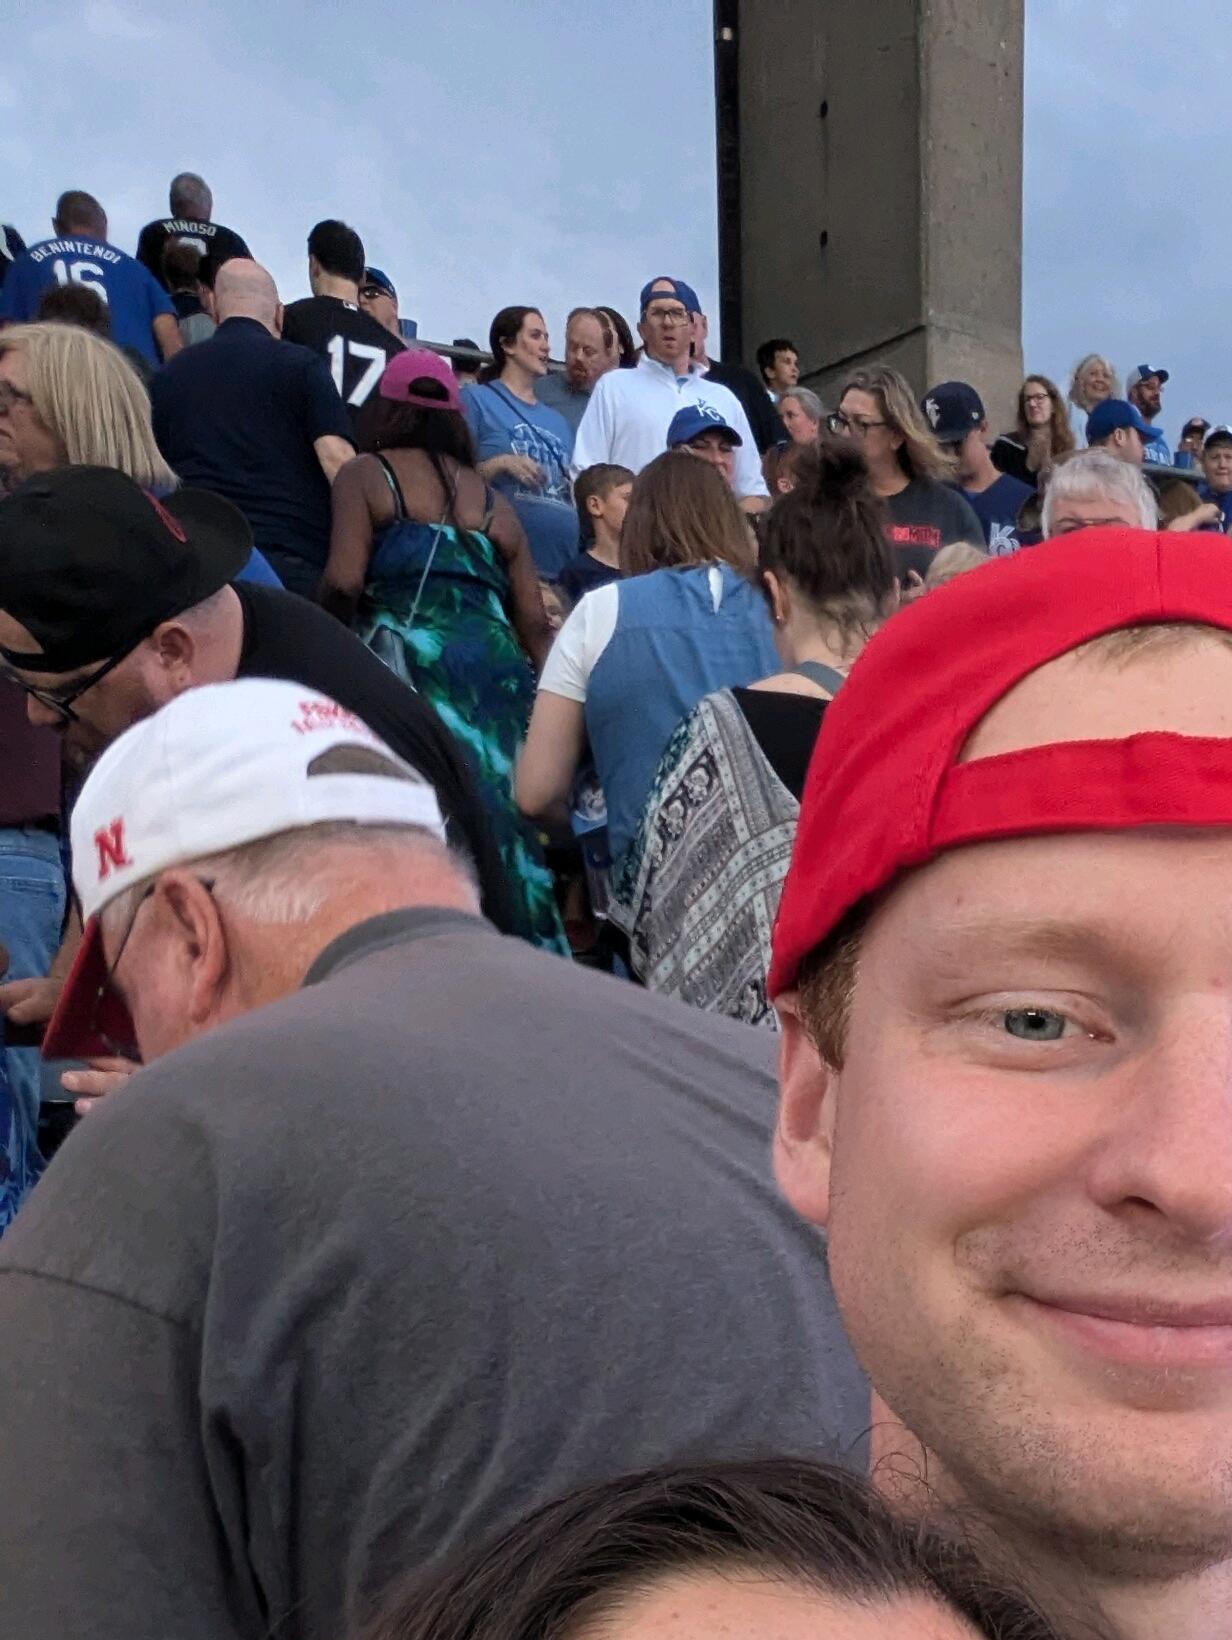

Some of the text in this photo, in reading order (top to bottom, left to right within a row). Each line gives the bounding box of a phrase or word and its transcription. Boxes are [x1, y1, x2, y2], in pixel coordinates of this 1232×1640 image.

[30, 240, 121, 264] BENINTENDI
[327, 334, 387, 408] 17
[94, 815, 125, 880] N
